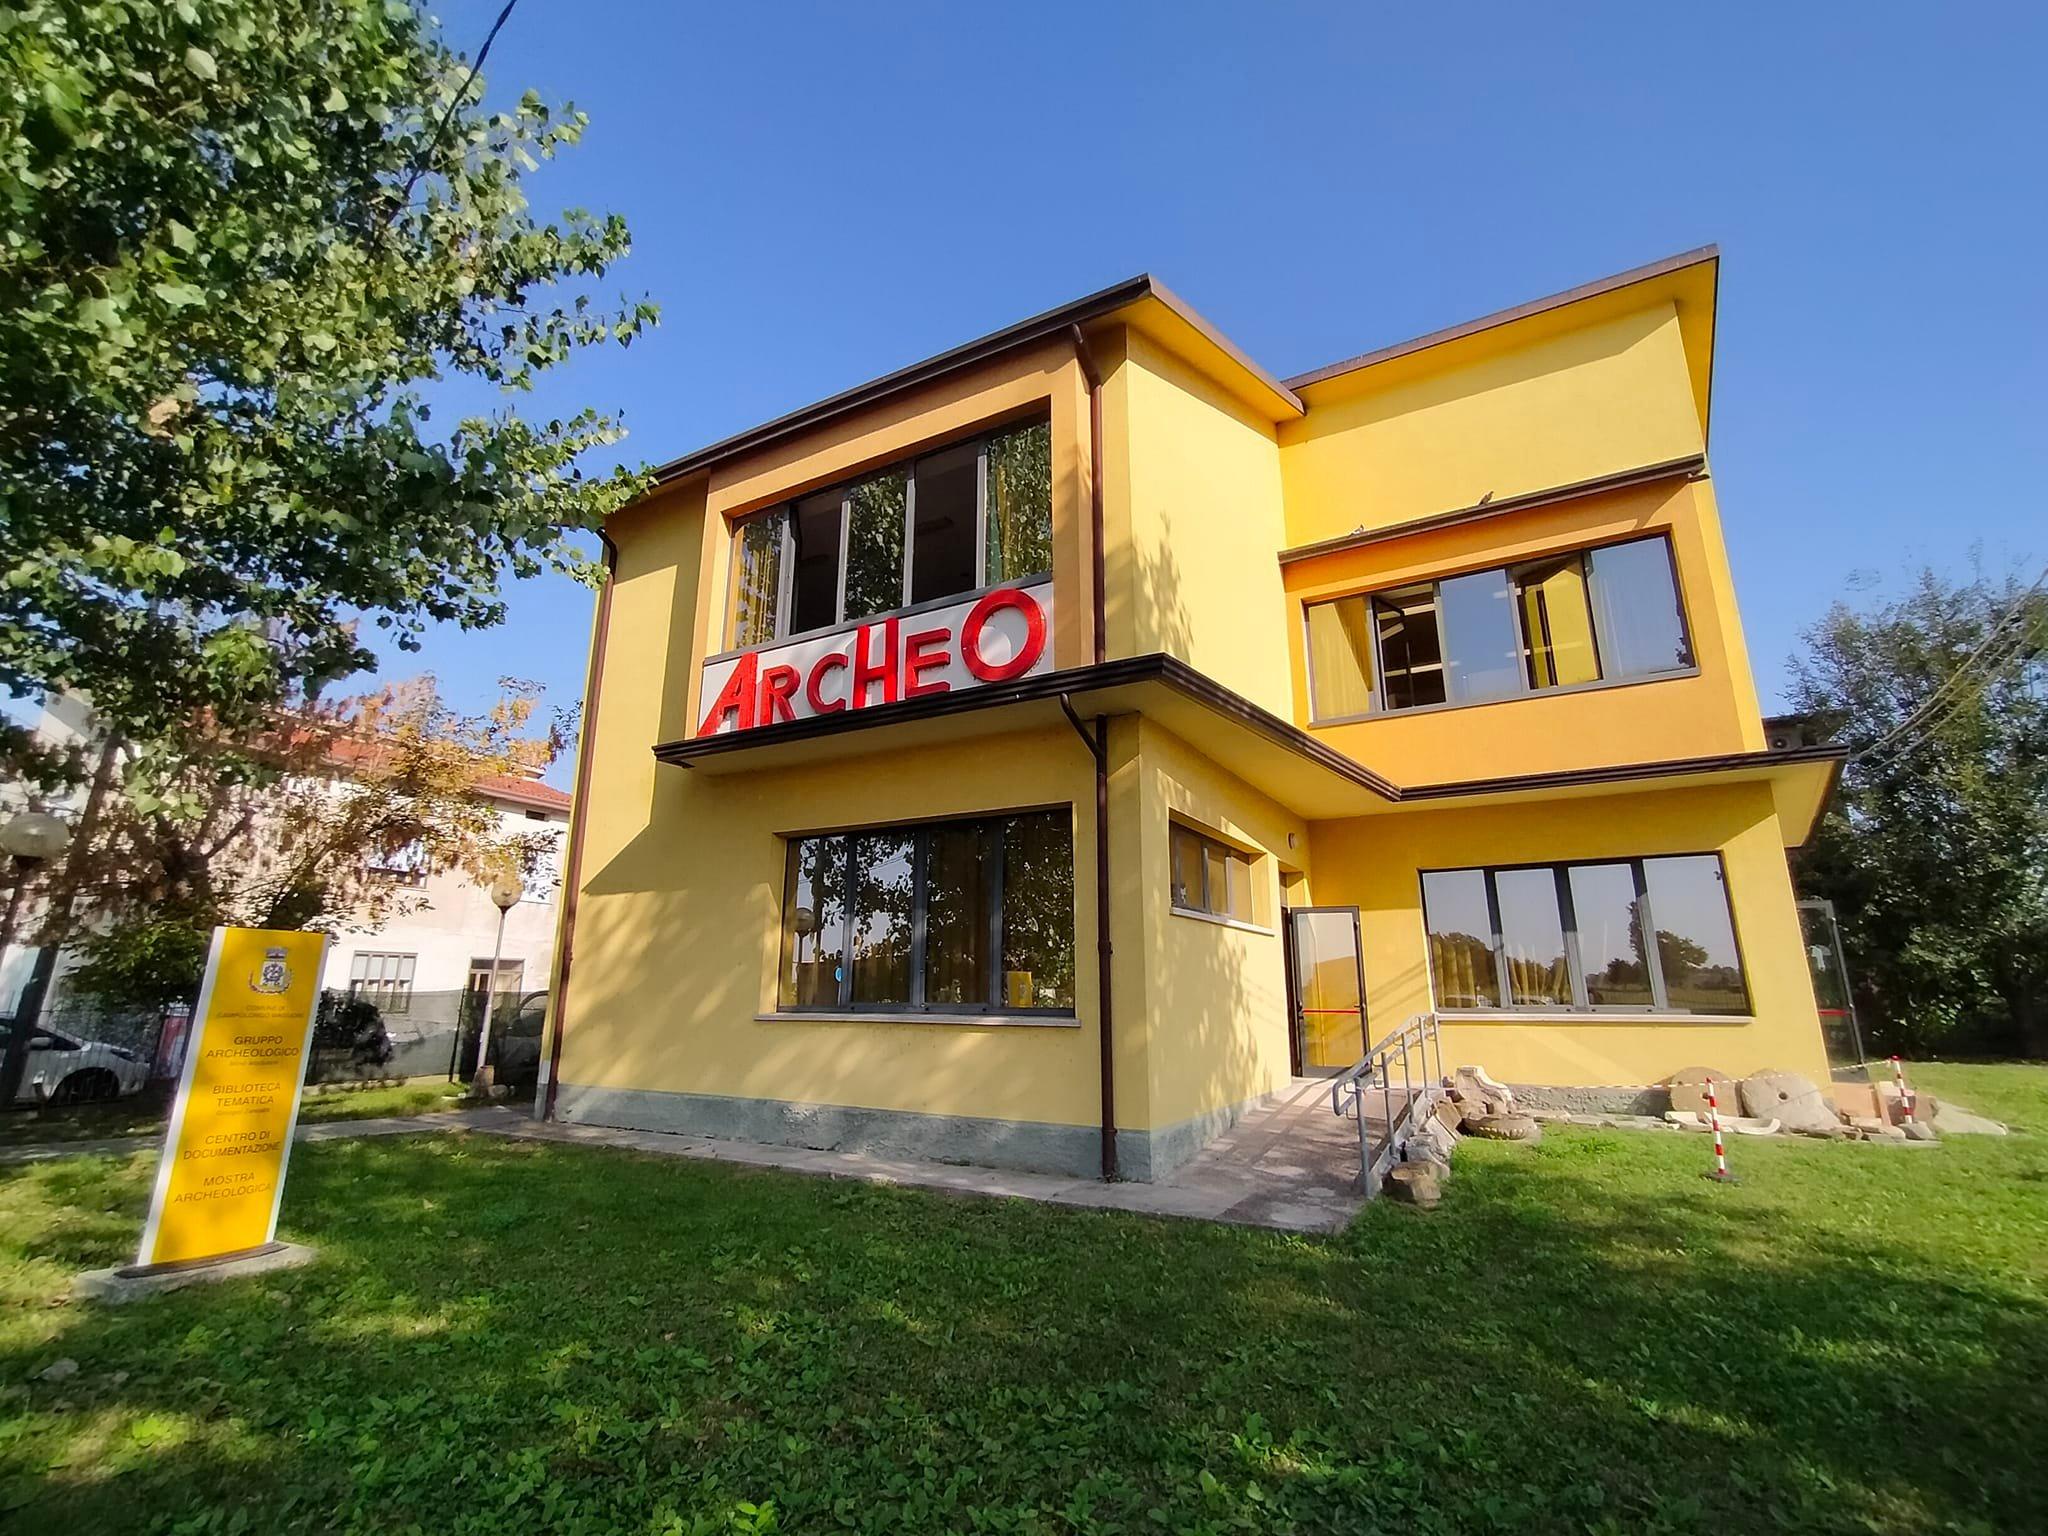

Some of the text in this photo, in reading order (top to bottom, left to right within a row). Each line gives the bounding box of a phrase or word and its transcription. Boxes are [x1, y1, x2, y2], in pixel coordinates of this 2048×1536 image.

[697, 588, 1047, 738] ARCHEO
[234, 1035, 283, 1045] GRUPPO
[206, 1047, 299, 1058] ARCHEOLOGICO
[212, 1082, 281, 1094] BIBLIOTECA
[217, 1096, 274, 1107] TEMATICA
[205, 1130, 271, 1144] CENTRO DI
[183, 1141, 281, 1160] DOCUMENTAZIONE
[203, 1172, 255, 1186] MOSTRA
[174, 1184, 272, 1203] ARCHEOLOGICA
